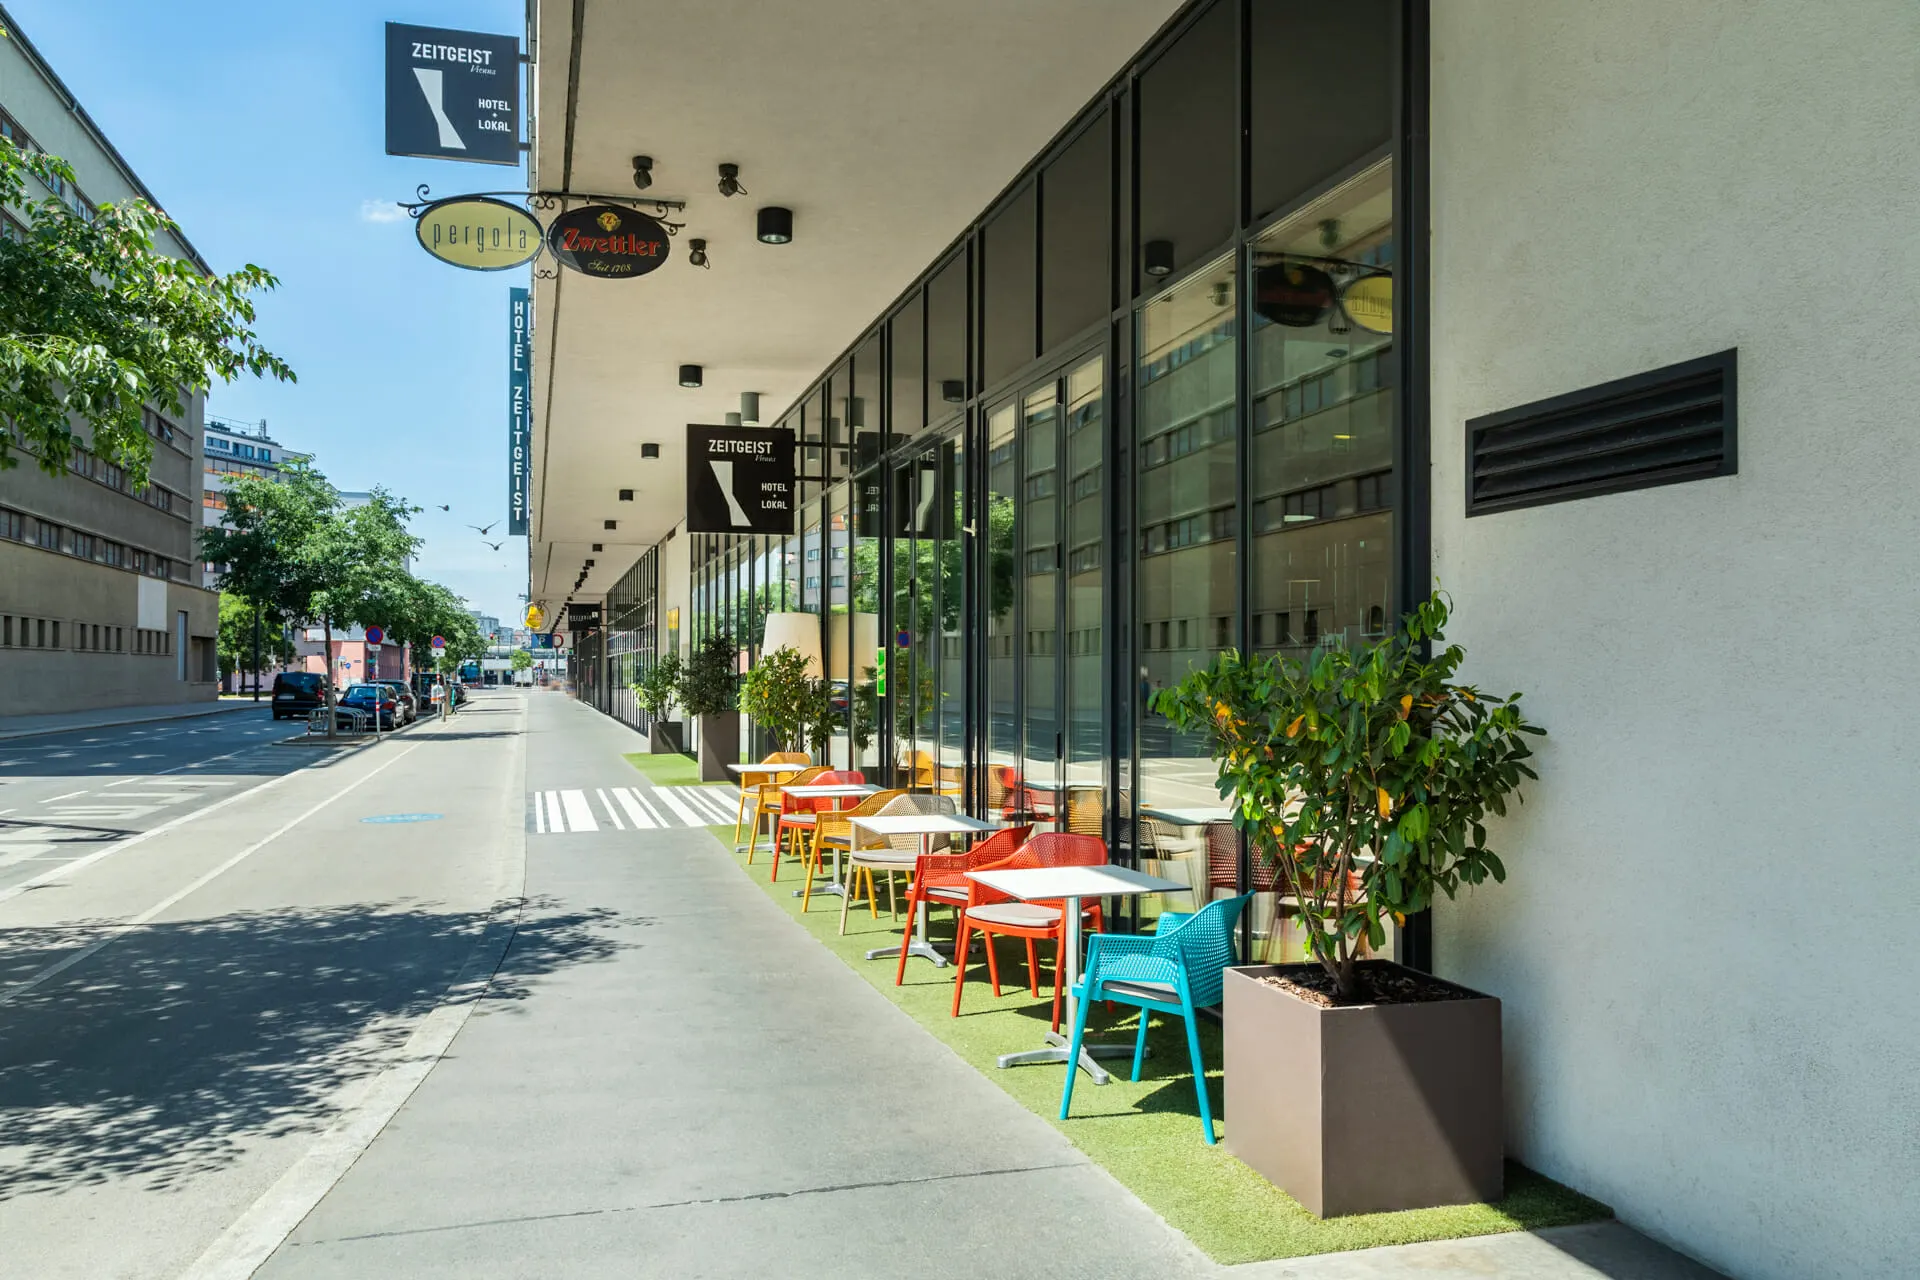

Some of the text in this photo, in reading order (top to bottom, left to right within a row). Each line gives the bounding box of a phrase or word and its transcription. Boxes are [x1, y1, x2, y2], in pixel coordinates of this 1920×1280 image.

[412, 42, 492, 65] ZEITGEIST
[478, 98, 511, 111] HOTEL
[478, 120, 511, 132] LOKAL
[433, 217, 527, 252] pergola
[562, 227, 661, 256] Zwettler
[588, 259, 632, 273] Seit 1708
[514, 301, 523, 521] HOTEL ZEITGEIST
[708, 439, 773, 454] ZEITGEIST
[761, 482, 788, 492] HOTEL
[761, 500, 788, 510] LOKAL
